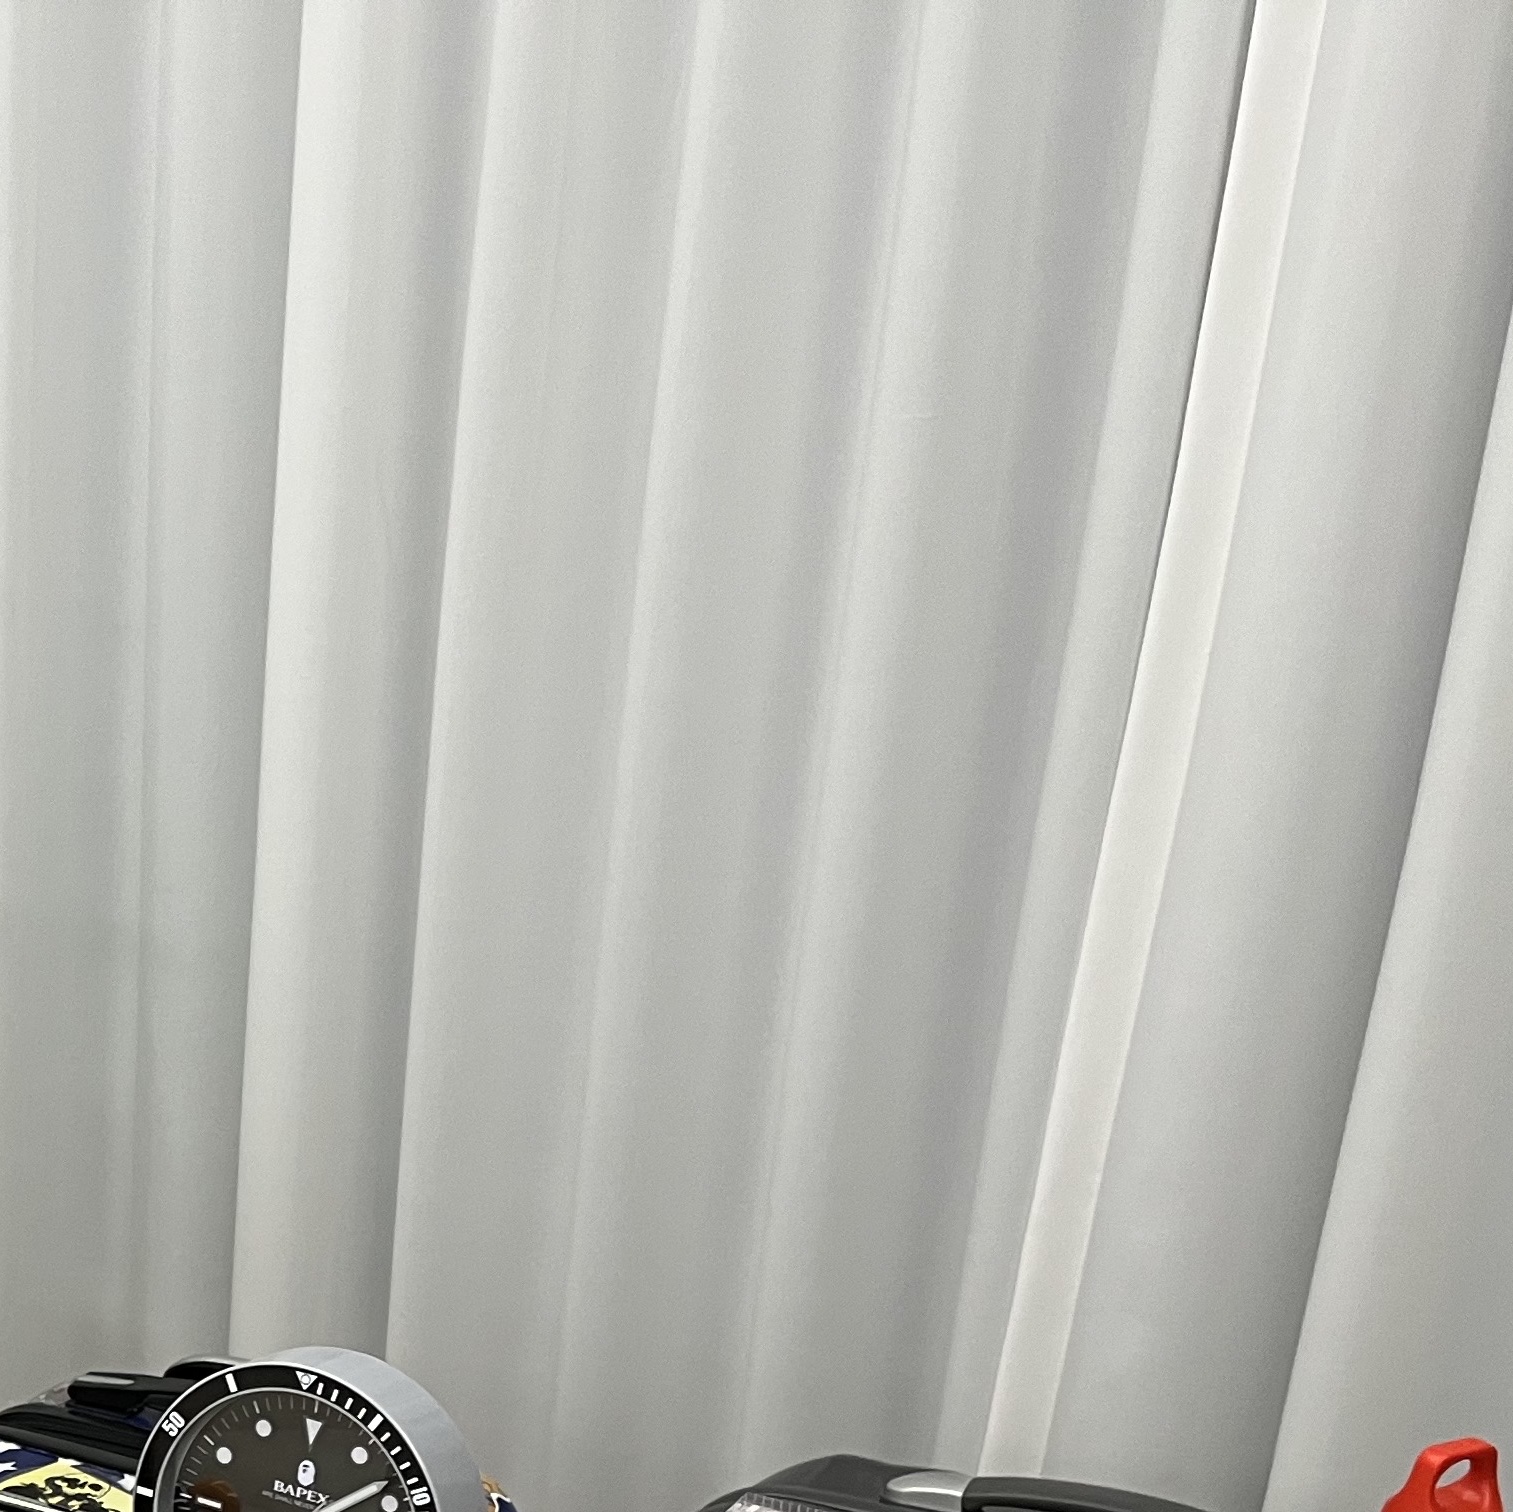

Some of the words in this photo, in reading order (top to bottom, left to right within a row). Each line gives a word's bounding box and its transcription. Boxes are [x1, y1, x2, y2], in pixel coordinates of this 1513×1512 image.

[161, 1410, 186, 1437] 50
[273, 1479, 330, 1505] BAPEX
[411, 1486, 431, 1507] 10
